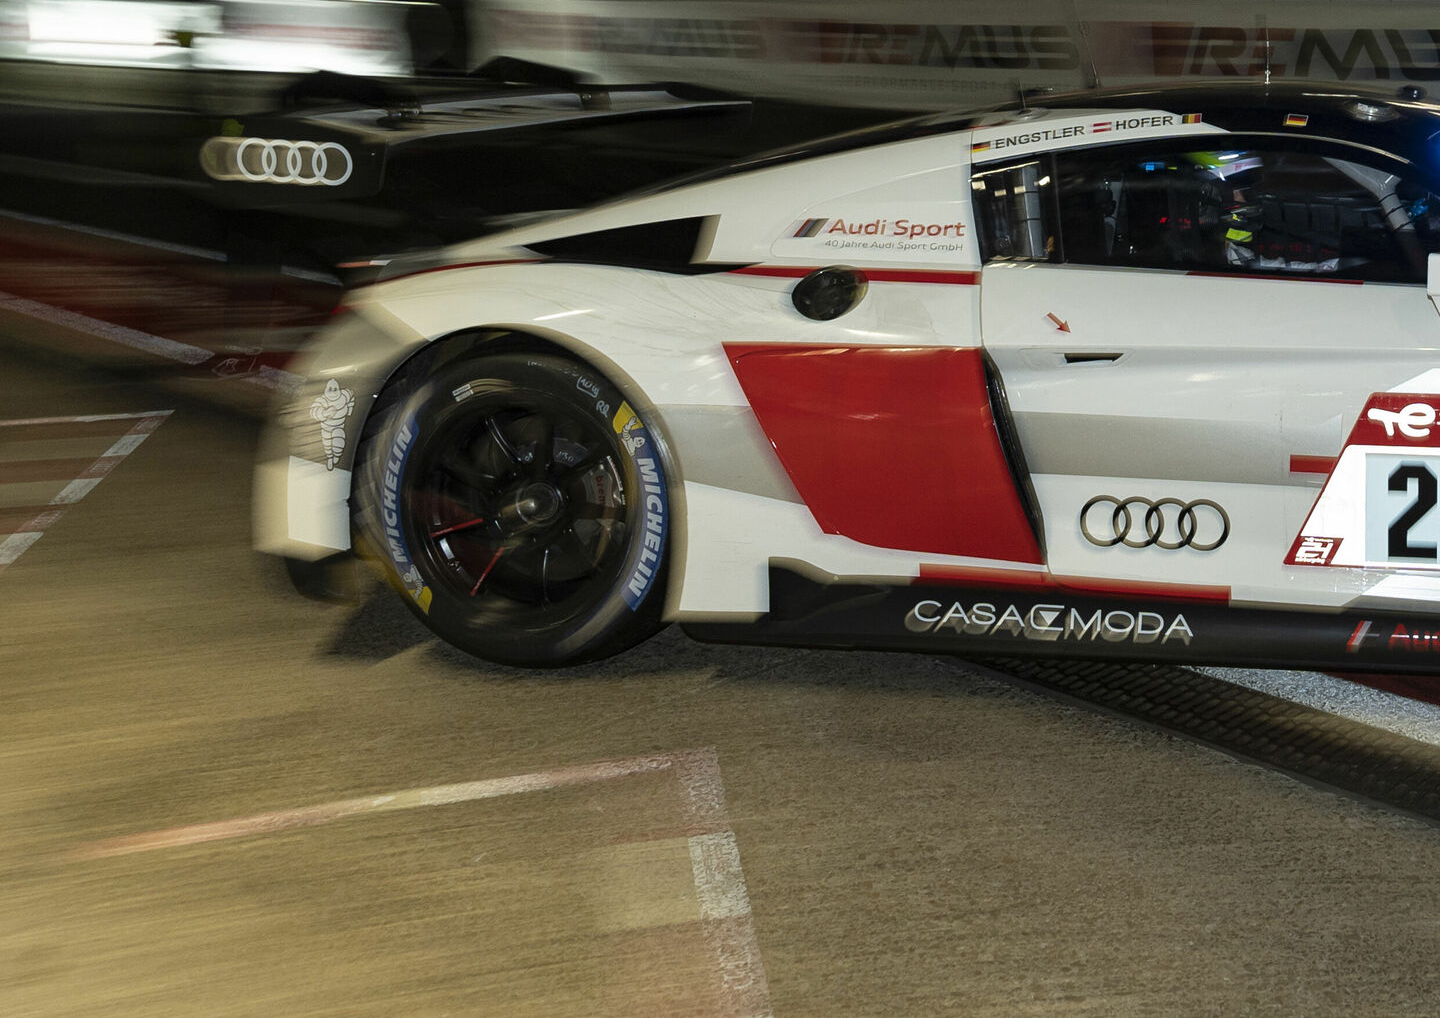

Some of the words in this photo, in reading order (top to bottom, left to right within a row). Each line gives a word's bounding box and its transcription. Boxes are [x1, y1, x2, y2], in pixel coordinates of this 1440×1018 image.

[846, 22, 1080, 70] REMUS
[1115, 115, 1174, 131] HOFER
[995, 125, 1085, 149] ENGSTLER
[828, 218, 887, 236] Audi
[893, 219, 967, 240] Sport
[824, 239, 839, 248] 40
[840, 240, 869, 249] Jahre
[870, 241, 894, 250] Audi
[897, 241, 926, 252] Sport
[930, 242, 964, 252] GmbH
[383, 425, 412, 563] MICHELIN
[630, 457, 665, 598] MICHELIN
